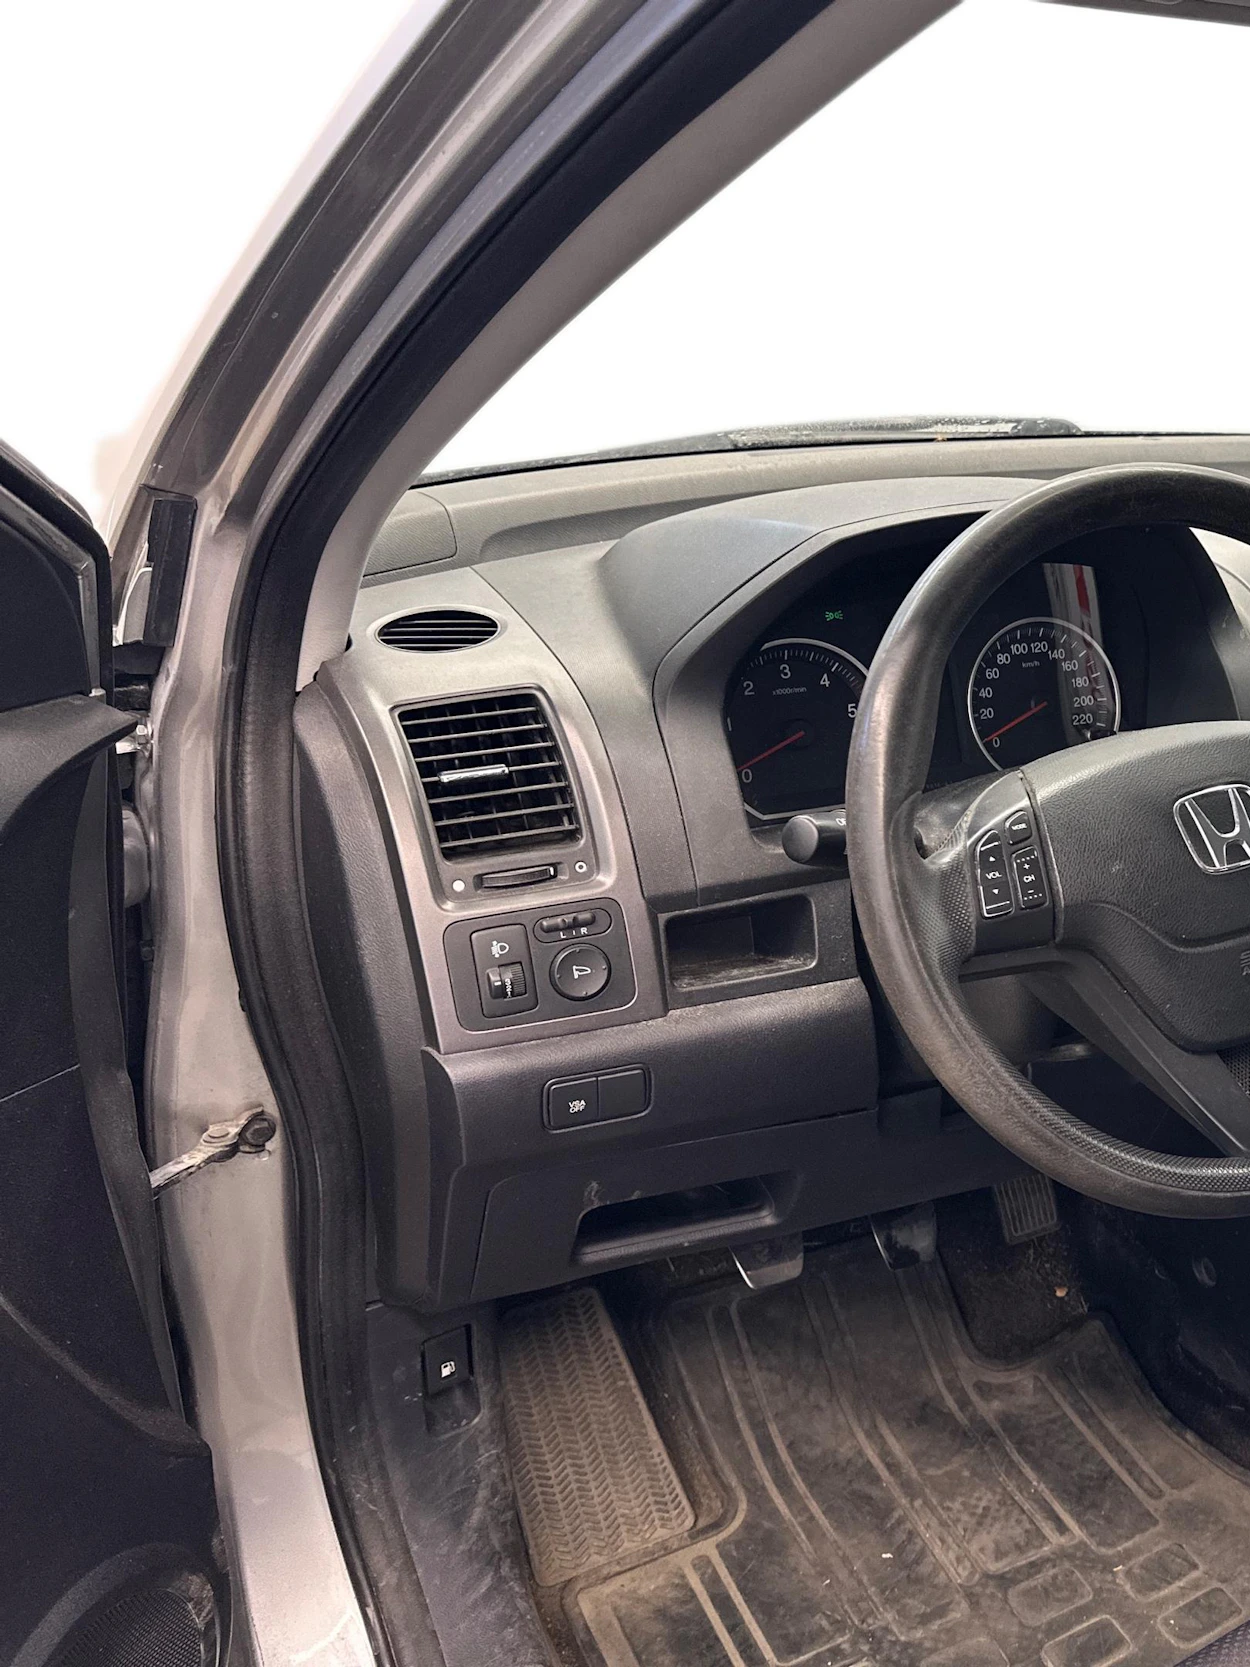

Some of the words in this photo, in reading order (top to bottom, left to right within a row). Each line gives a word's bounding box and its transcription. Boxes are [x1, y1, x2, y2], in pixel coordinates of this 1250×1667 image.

[1010, 643, 1028, 655] 100
[1030, 641, 1048, 654] 120
[996, 653, 1011, 665] 80
[1048, 649, 1066, 660] 140
[1022, 660, 1040, 668] km/h
[1061, 660, 1079, 671] 160
[780, 664, 791, 679] 3
[985, 668, 1000, 680] 60
[820, 673, 830, 687] 4
[1071, 676, 1090, 688] 180
[743, 681, 755, 695] 2
[979, 687, 993, 698] 40
[1073, 695, 1094, 707] 200
[847, 703, 857, 718] 5
[980, 708, 994, 719] 20
[1072, 713, 1094, 725] 220
[992, 737, 1000, 748] 0
[741, 769, 752, 783] 0
[985, 871, 1002, 880] VOL
[1023, 874, 1035, 883] CH
[560, 931, 567, 939] L
[580, 927, 588, 935] R
[568, 1099, 586, 1109] VSA
[569, 1105, 585, 1113] OFF
